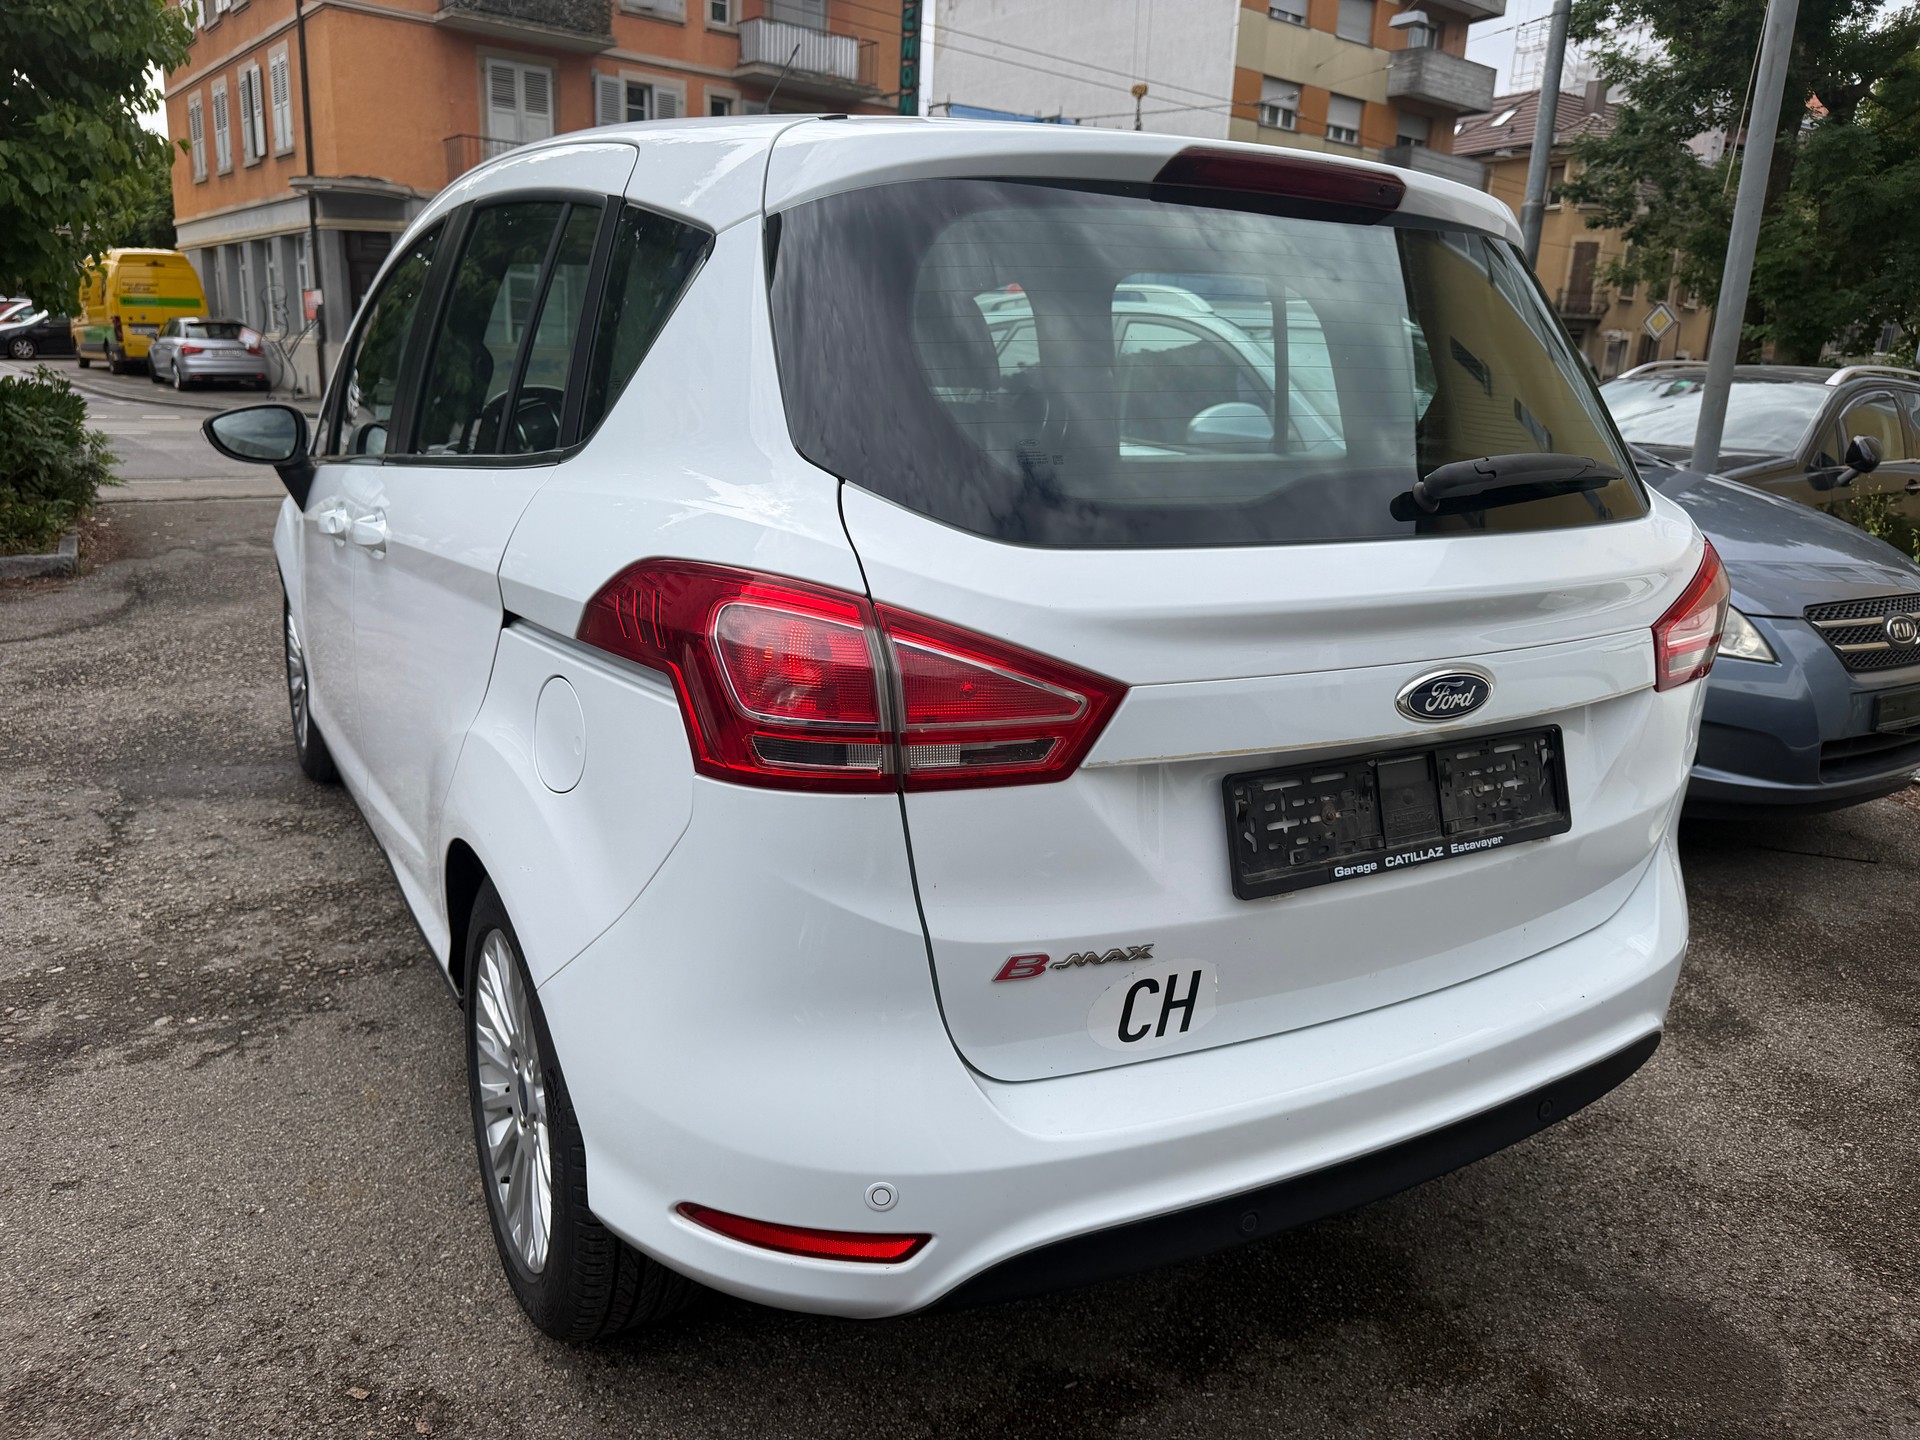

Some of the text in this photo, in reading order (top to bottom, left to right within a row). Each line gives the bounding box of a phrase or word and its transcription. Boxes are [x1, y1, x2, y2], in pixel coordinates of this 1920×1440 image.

[1892, 622, 1914, 638] KIA
[1425, 681, 1476, 712] Ford
[1334, 835, 1503, 877] Garage CATILLAZ Estavayer
[991, 943, 1155, 982] B-MAX
[1117, 970, 1202, 1043] CH
